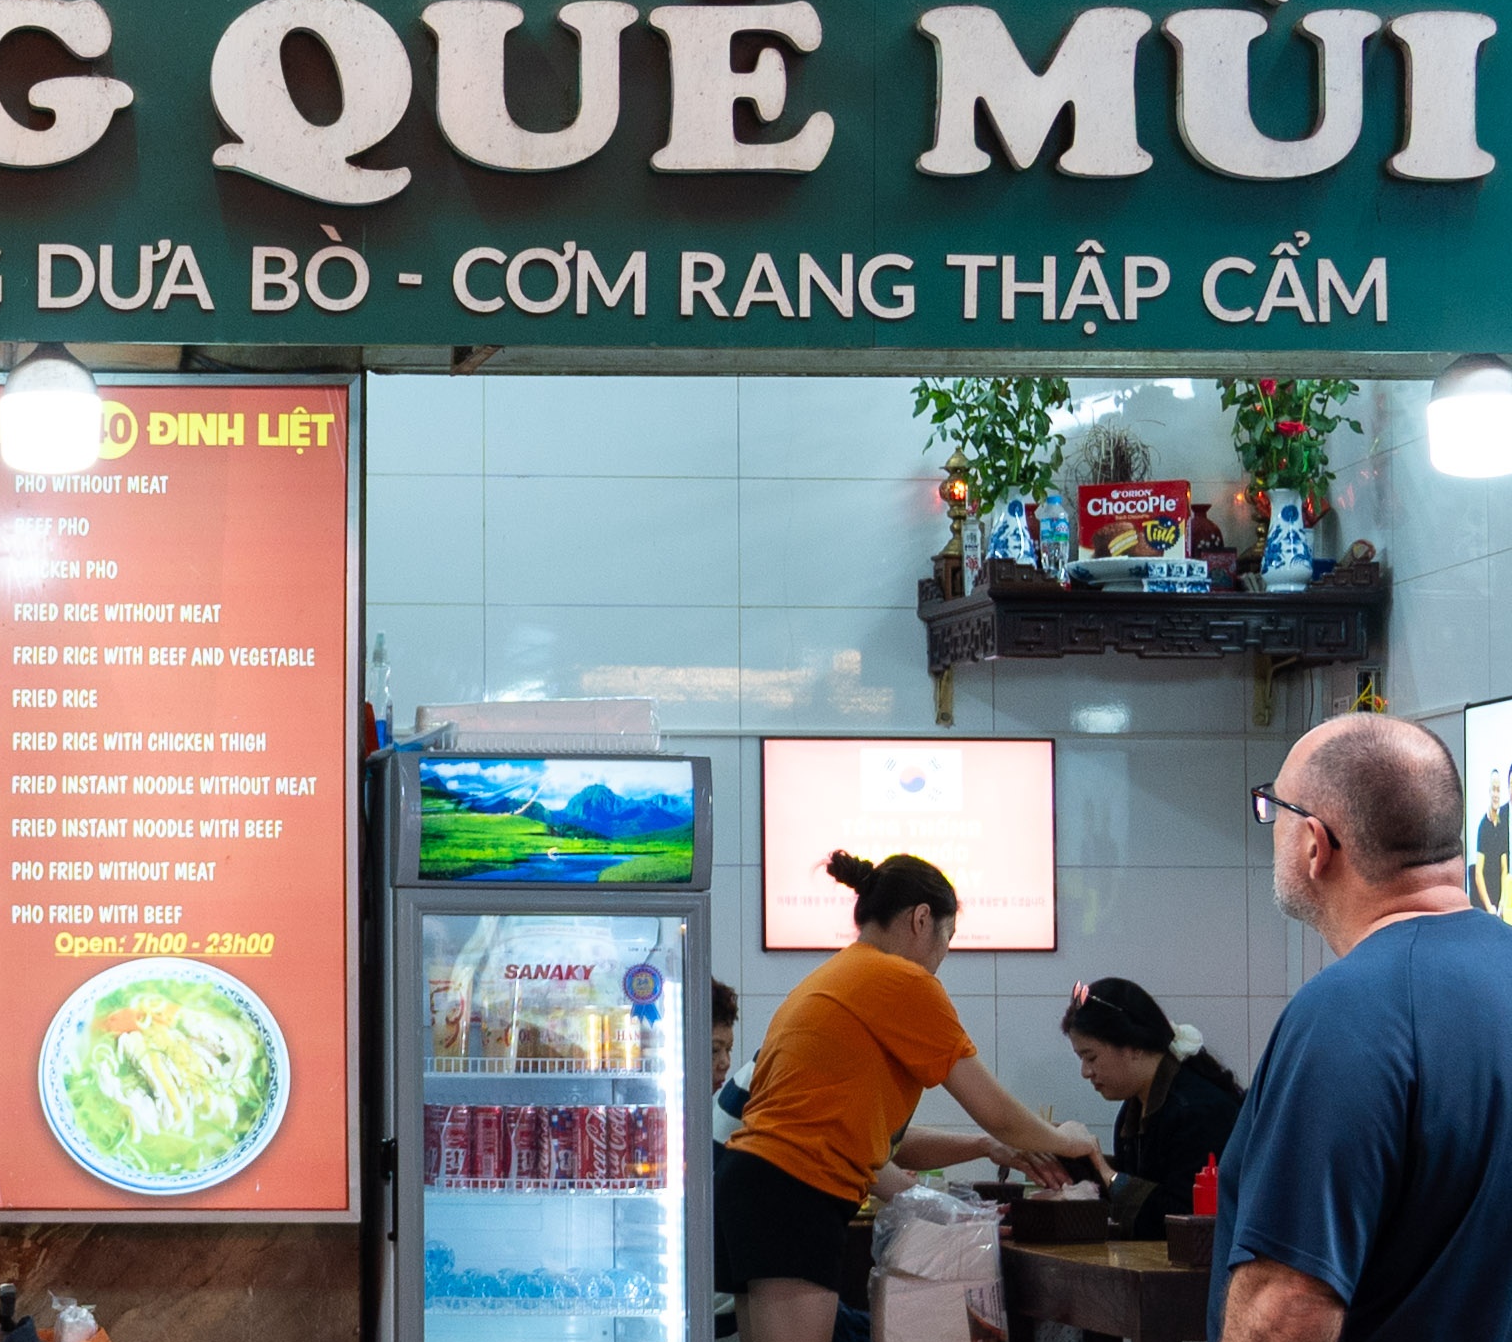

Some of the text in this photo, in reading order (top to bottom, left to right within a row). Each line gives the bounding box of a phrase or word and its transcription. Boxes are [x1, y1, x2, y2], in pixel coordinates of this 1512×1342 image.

[37, 238, 216, 311] DƯA
[251, 223, 370, 312] BÒ
[452, 240, 647, 316] CƠM
[680, 251, 916, 320] RANG
[946, 239, 1171, 332] THẬP
[1202, 230, 1388, 323] CẨM
[147, 411, 246, 446] ĐINH
[257, 405, 336, 455] LIỆT
[14, 474, 169, 495] PHO WITHOUT MEAT
[1086, 493, 1177, 516] ChocoPie
[57, 517, 90, 537] PHO
[14, 602, 222, 624] FRIED RICE WITHOUT MEAT
[13, 645, 315, 667] FRIED RICE WITH BEEF AND VEGETABLE
[12, 688, 98, 709] FRIED RICE
[12, 731, 267, 753] FRIED RICE WITH CHICKEN THIGH
[11, 775, 317, 796] FRIED INSTANT NOODLE WITHOUT MEAT
[11, 818, 283, 839] FRIED INSTANT NOODLE WITH BEEF
[11, 860, 216, 882] PHO FRIED WITHOUT MEAT
[11, 904, 183, 925] PHO FRIED WITH BEEF
[54, 931, 275, 954] Open: 7h00 23h00
[503, 963, 596, 981] SANAKY
